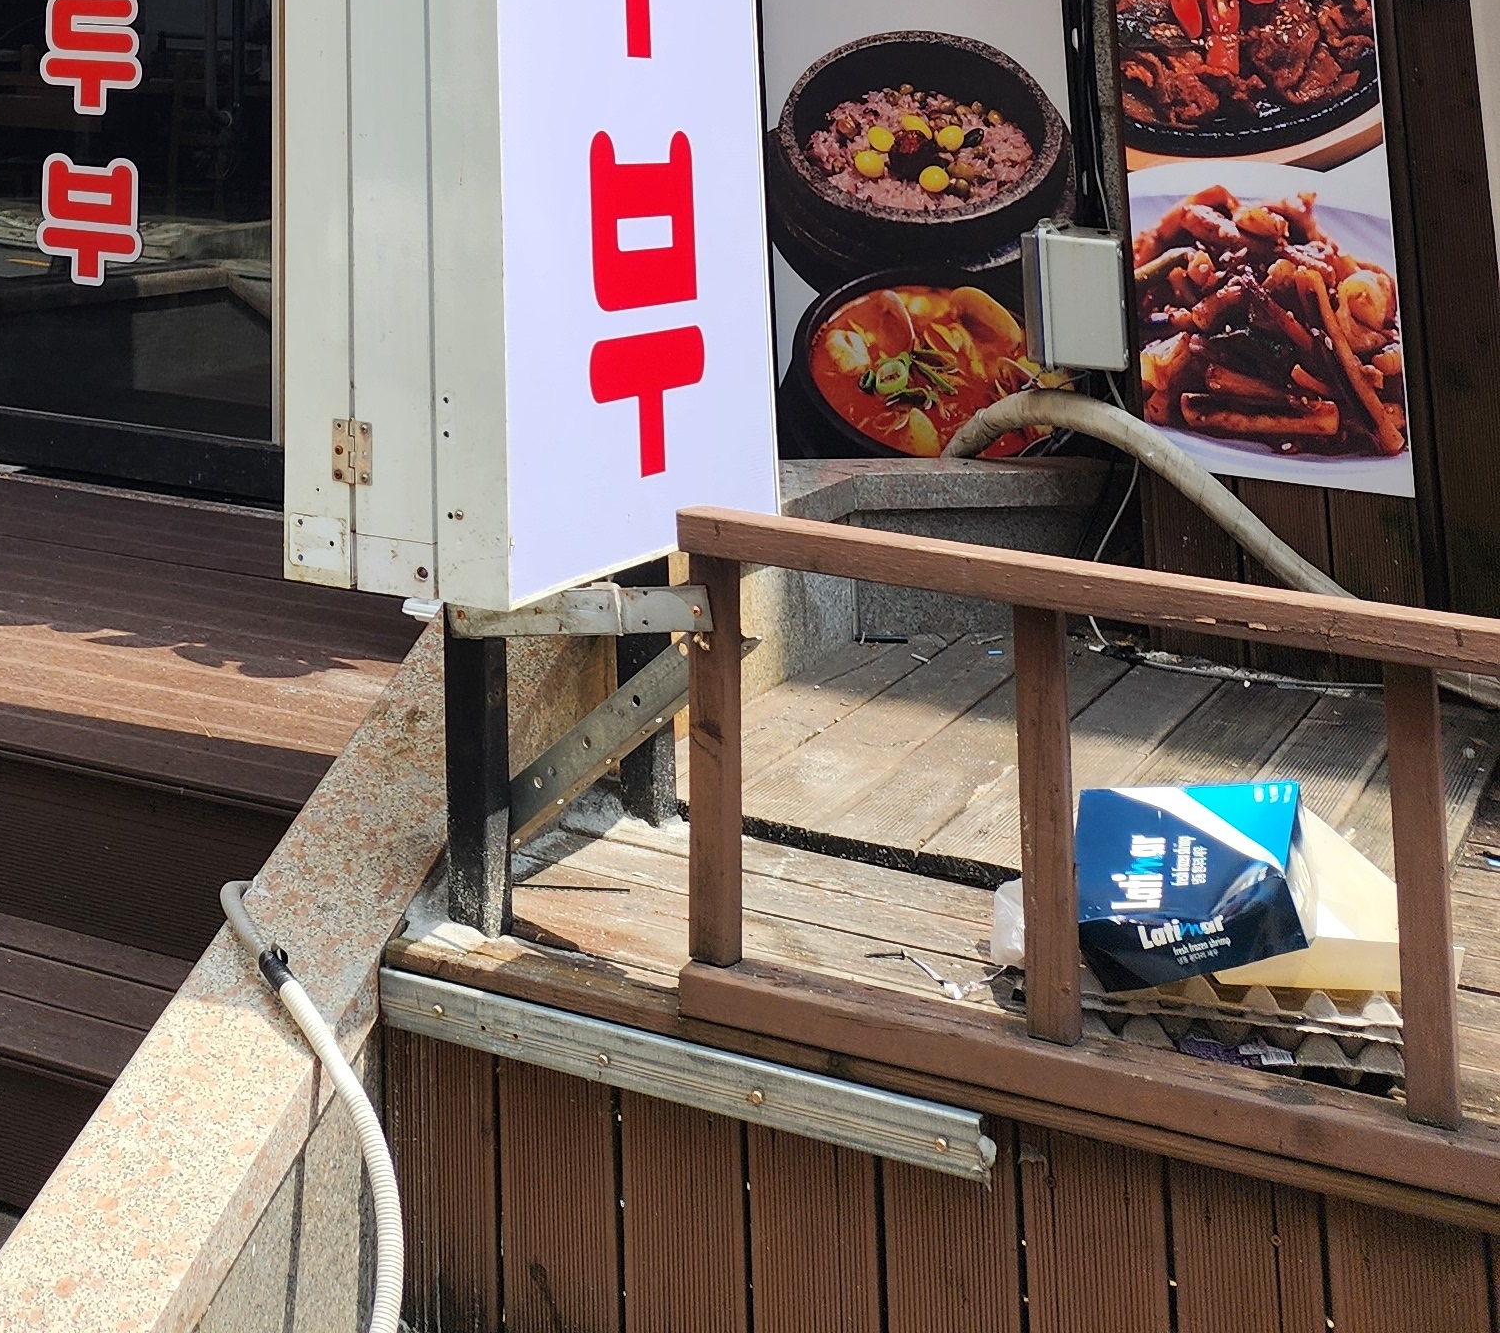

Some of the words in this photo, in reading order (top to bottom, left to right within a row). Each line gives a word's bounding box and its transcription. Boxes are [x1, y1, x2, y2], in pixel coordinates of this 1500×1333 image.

[1111, 834, 1166, 910] Latimar
[1137, 912, 1225, 951] Latimar
[1173, 941, 1189, 957] fresh
